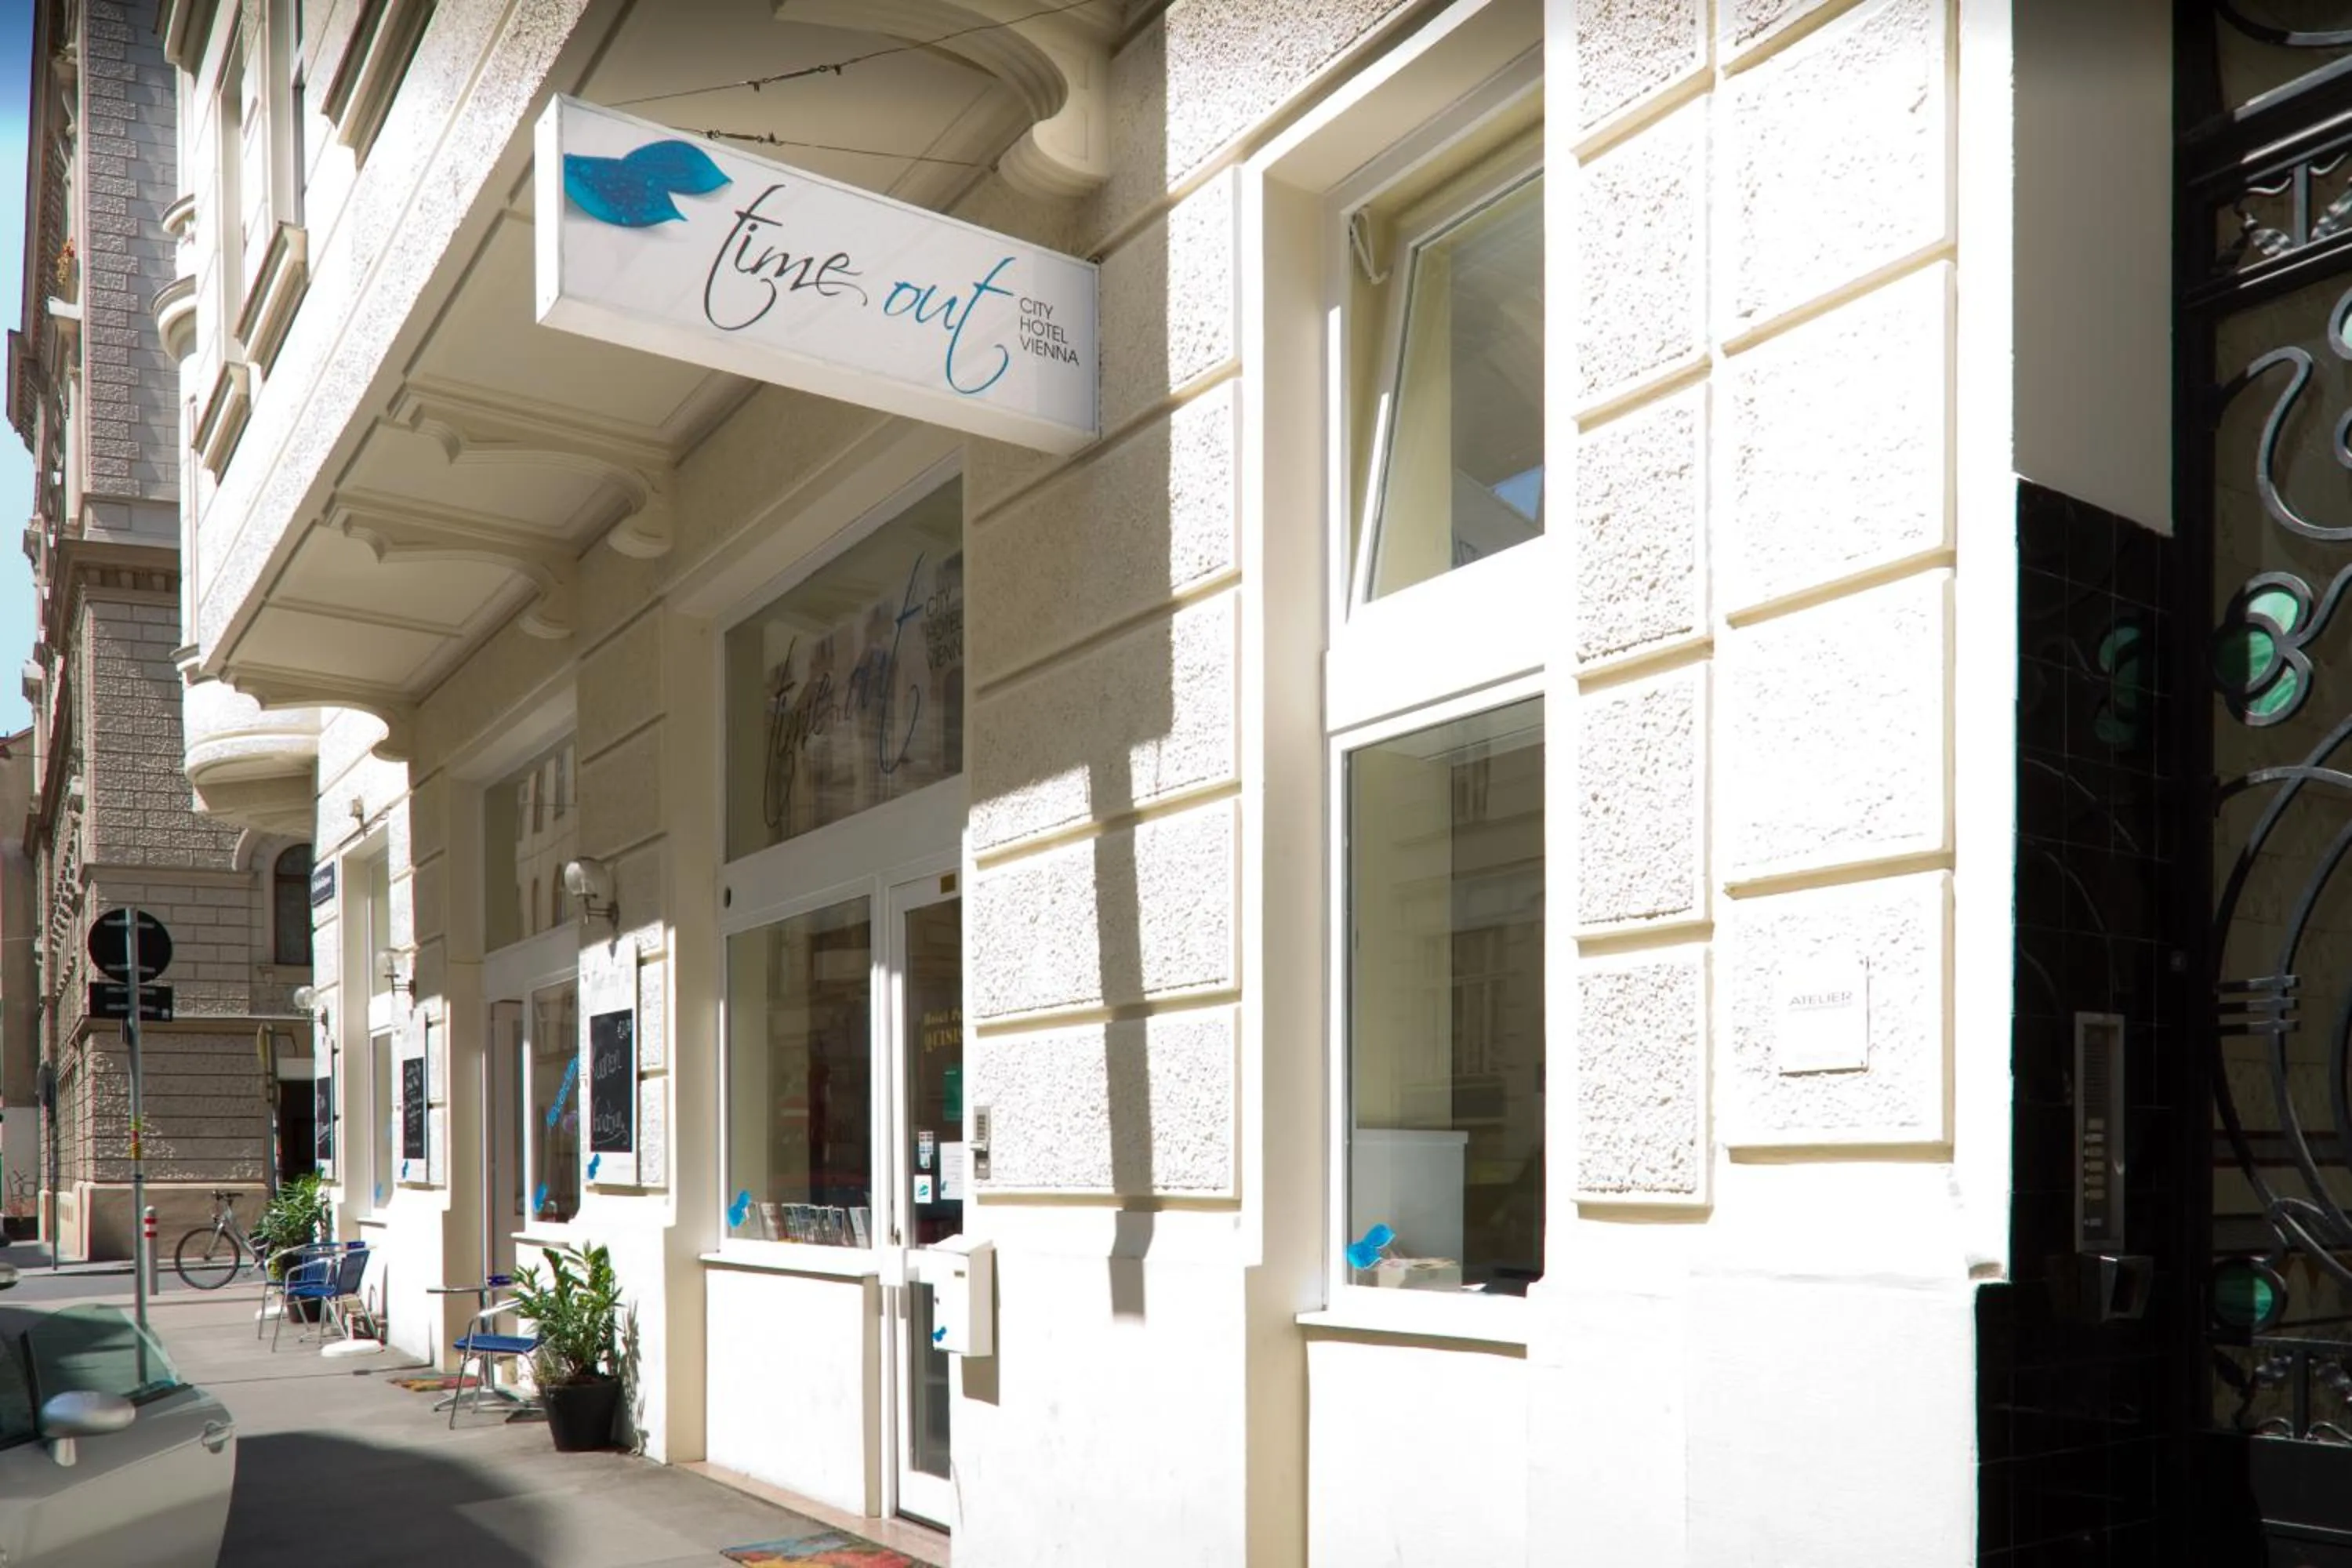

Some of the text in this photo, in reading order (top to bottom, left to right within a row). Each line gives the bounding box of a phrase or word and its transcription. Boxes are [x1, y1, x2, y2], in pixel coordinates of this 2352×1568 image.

[704, 184, 1017, 394] time out
[1019, 296, 1054, 319] CITY
[1020, 315, 1069, 344] HOTEL
[1020, 335, 1080, 366] VIENNA
[926, 583, 952, 618] CITY
[926, 637, 963, 671] VIENN
[1788, 990, 1853, 1007] ATELIER
